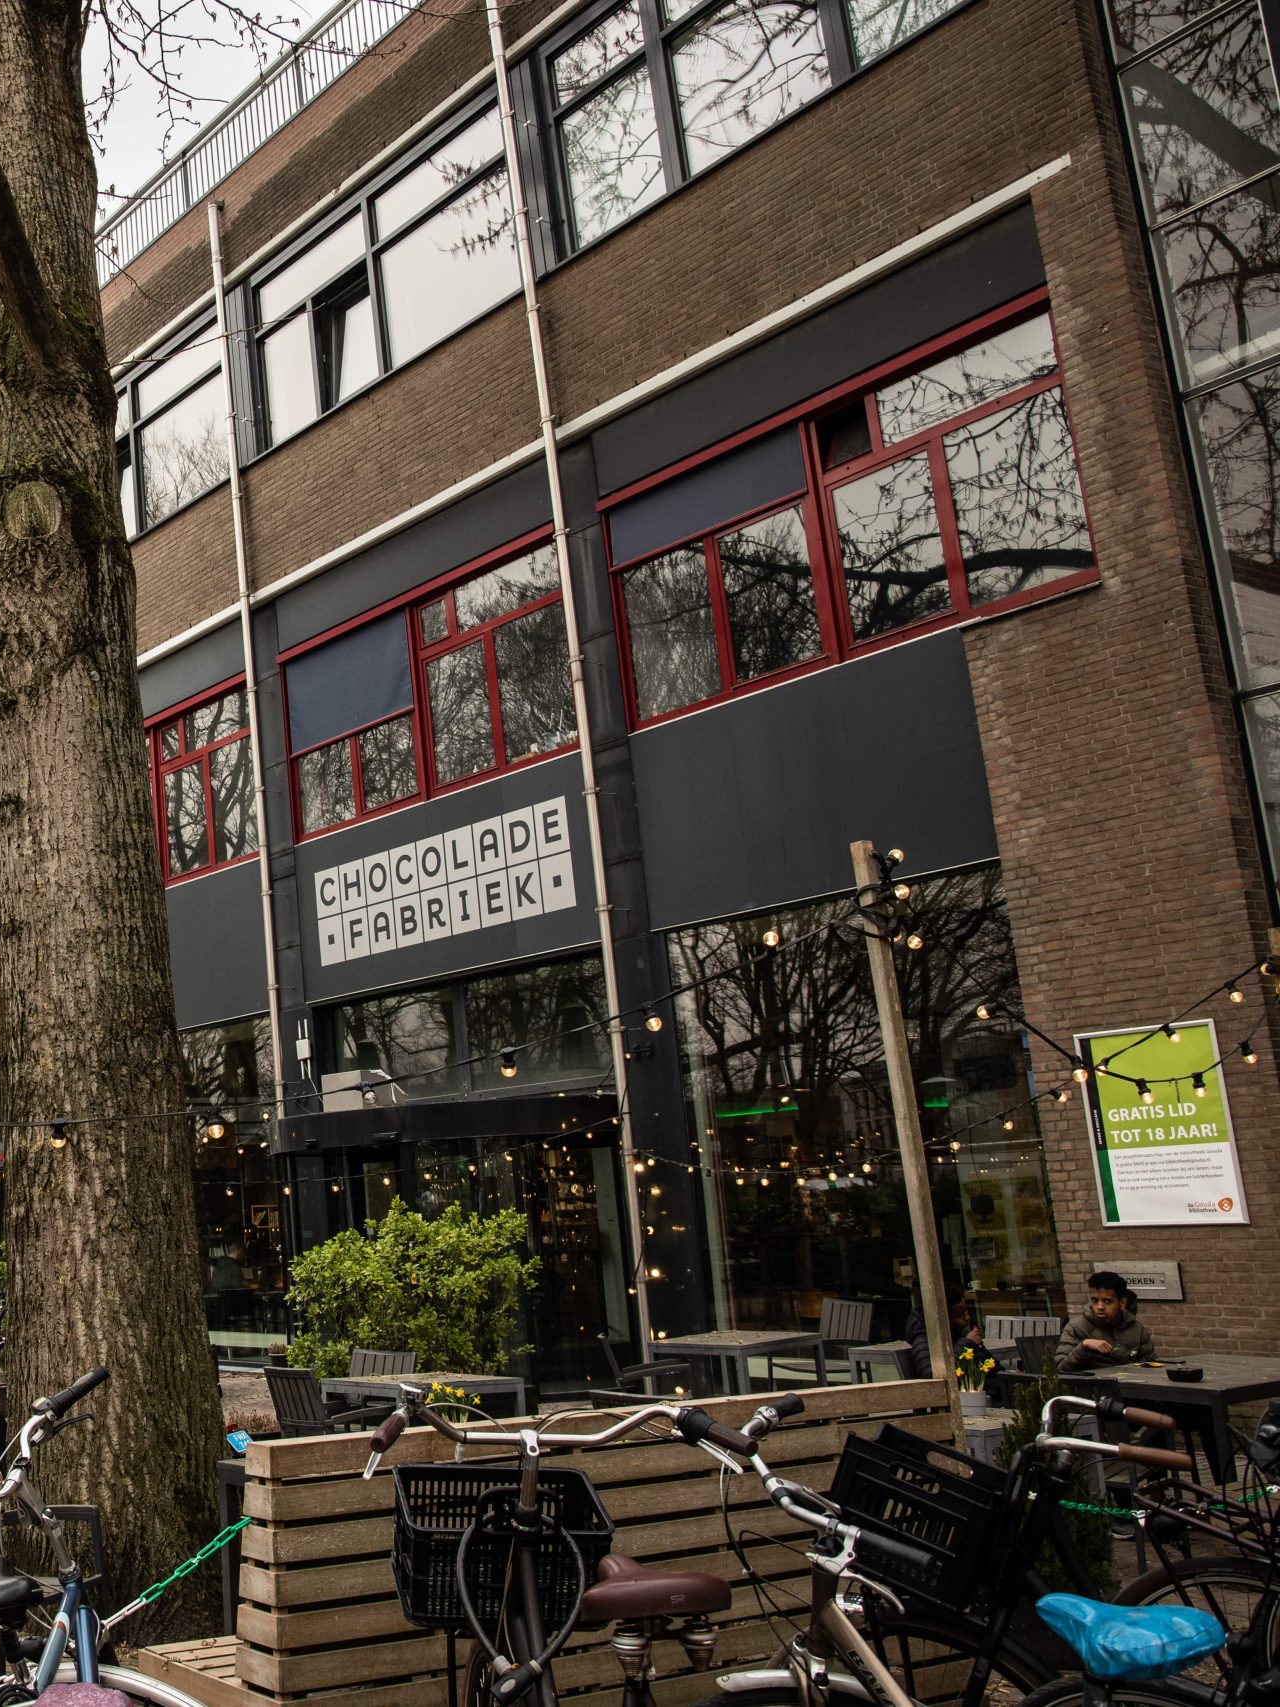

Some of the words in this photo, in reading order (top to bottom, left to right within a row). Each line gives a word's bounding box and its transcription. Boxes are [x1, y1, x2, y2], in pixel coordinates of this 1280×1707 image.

[319, 808, 563, 907] CHOCOLADE
[348, 871, 537, 949] FABRIEK
[1108, 1104, 1165, 1122] GRATIS
[1168, 1102, 1197, 1118] LID
[1110, 1129, 1141, 1144] TOT
[1145, 1127, 1166, 1142] 18
[1168, 1123, 1219, 1140] JAAR!
[1125, 1277, 1155, 1285] OEKEN
